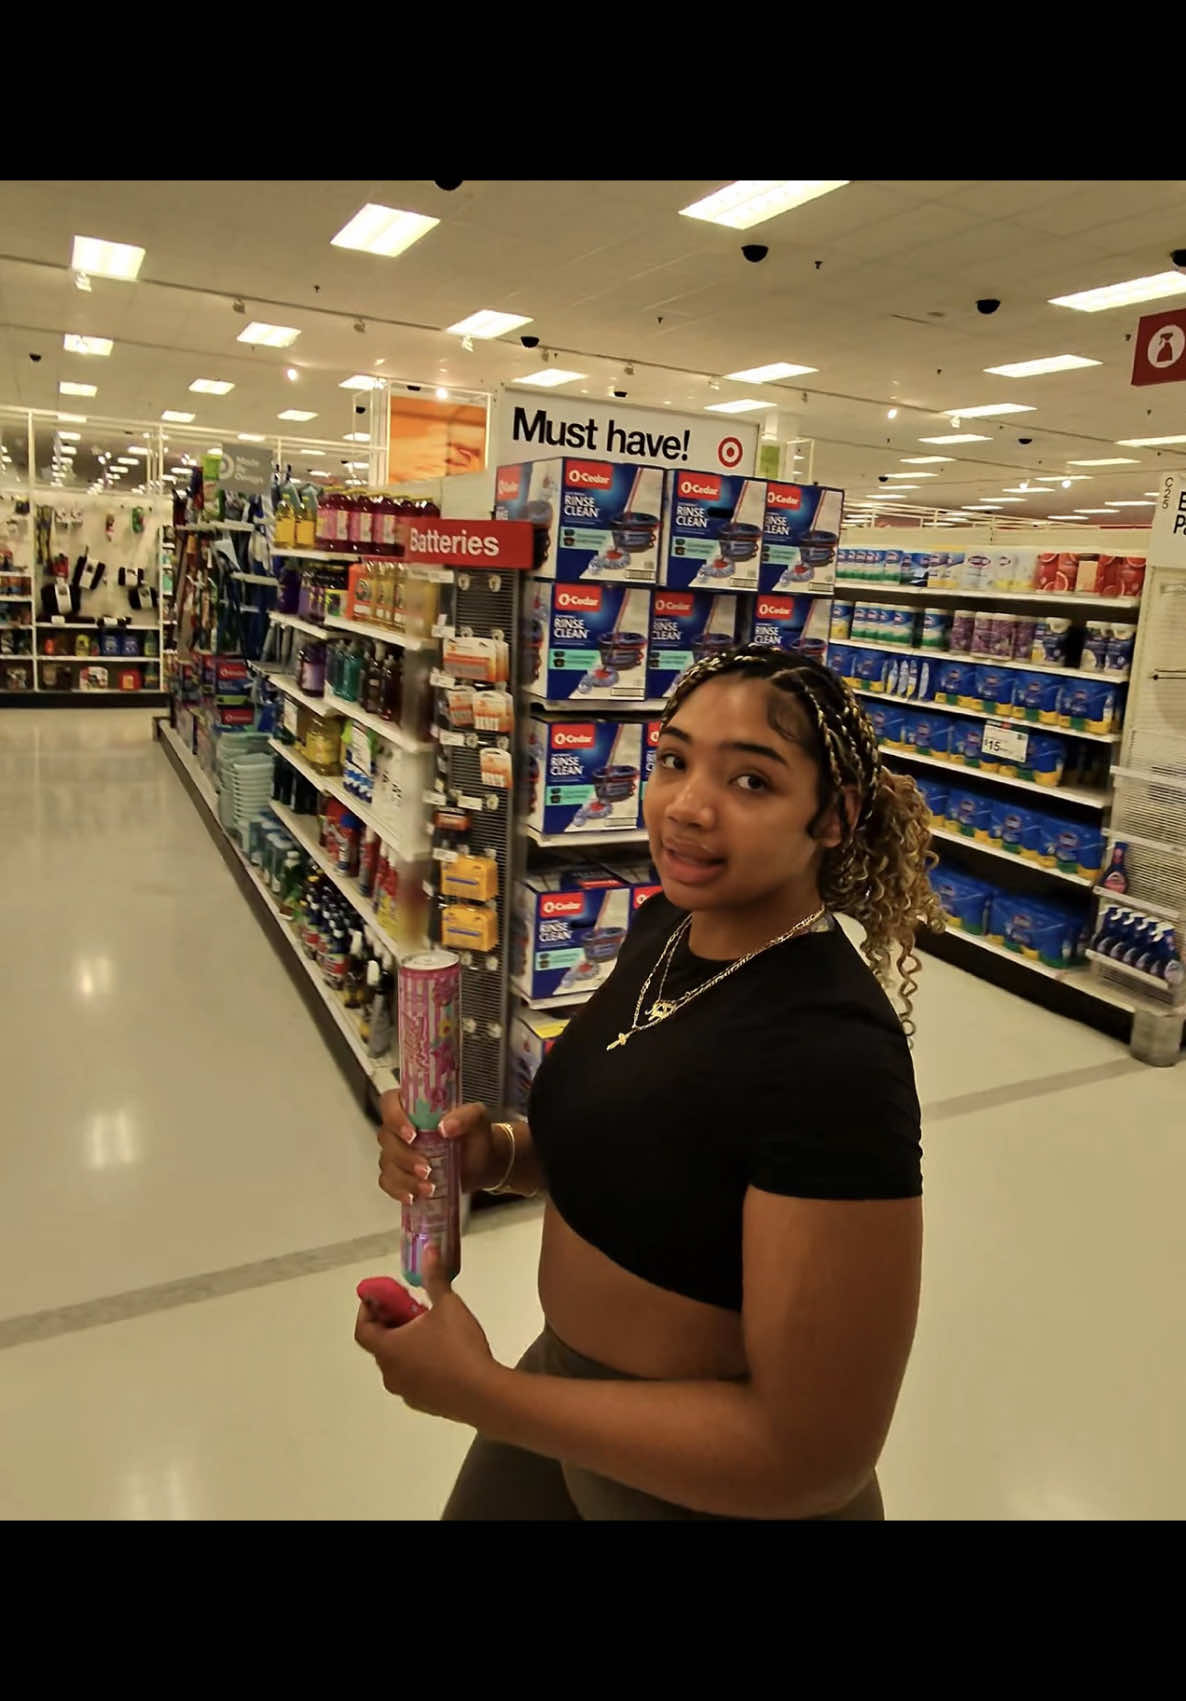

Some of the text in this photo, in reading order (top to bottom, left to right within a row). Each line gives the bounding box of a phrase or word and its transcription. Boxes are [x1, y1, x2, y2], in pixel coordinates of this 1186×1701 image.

[513, 407, 690, 461] Must have!
[564, 495, 595, 508] RINSE
[564, 505, 600, 519] CLEAN
[675, 506, 705, 518] RINSE
[675, 515, 709, 528] CLEAN
[409, 528, 499, 557] Batteries
[553, 617, 585, 630] RINSE
[553, 627, 588, 639] CLEAN
[550, 764, 584, 776] CLEAN
